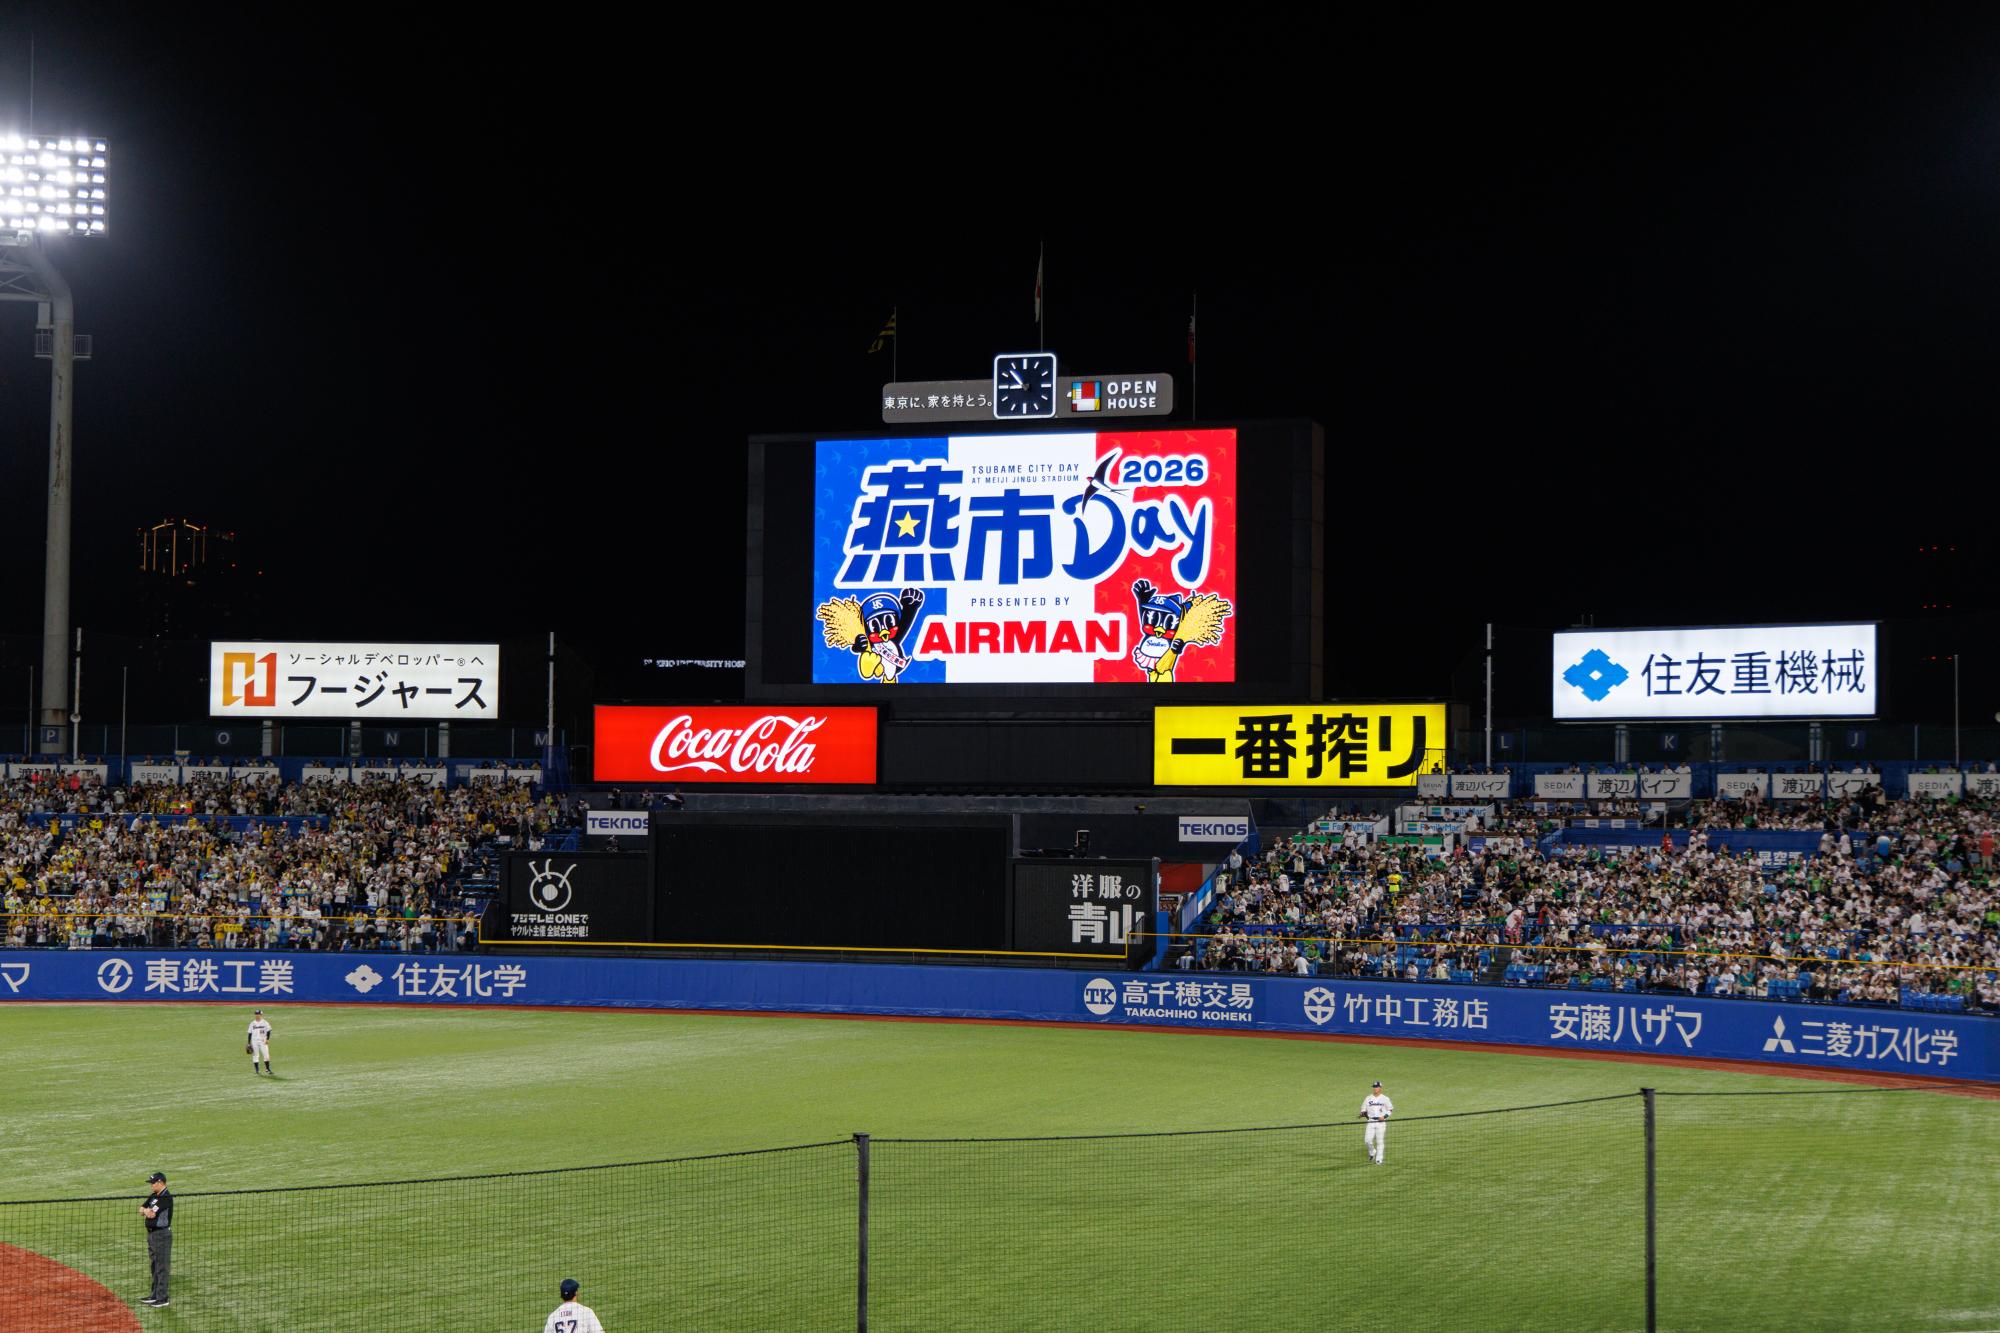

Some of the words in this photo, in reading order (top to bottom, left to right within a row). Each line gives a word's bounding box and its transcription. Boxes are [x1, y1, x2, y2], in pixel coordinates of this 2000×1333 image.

[1107, 380, 1157, 395] OPEN
[884, 394, 992, 409] 東京に、家を持とう。
[1107, 397, 1156, 409] HOUSE
[972, 465, 1022, 475] TSUBAME
[1028, 464, 1053, 473] CITY
[1059, 463, 1079, 472] DAY
[1122, 459, 1204, 483] 2026
[972, 477, 981, 485] AT
[1041, 475, 1079, 483] STADIUM
[971, 596, 1047, 607] PRESENTED
[1055, 596, 1070, 606] BY
[920, 620, 1120, 654] AIRMAN
[1641, 648, 1866, 696] 住友重機械
[287, 670, 487, 709] フージャース
[46, 729, 56, 742] P
[386, 733, 397, 745] N
[535, 733, 548, 746] M
[1501, 736, 1509, 749] L
[1664, 735, 1674, 749] K
[1851, 732, 1859, 747] J
[650, 715, 828, 774] Coca-Cola
[1455, 780, 1506, 791] 渡辺パイプ
[1597, 778, 1680, 794] 渡辺パイプ
[1180, 823, 1248, 836] TEKNOS
[1072, 873, 1142, 899] 洋服の
[511, 913, 589, 924] フジテレビONEで
[1068, 901, 1146, 945] 青山
[145, 957, 294, 995] 東鉄工業
[391, 962, 527, 998] 住友化学
[1122, 979, 1254, 1009] 高千穂交易
[1125, 1007, 1198, 1019] TAKACHIHO
[1202, 1011, 1252, 1022] KOHEKI
[1344, 992, 1489, 1030] 竹中工務店
[1549, 1002, 1703, 1048] 安藤ハザマ
[1800, 1021, 1958, 1066] 三菱ガス化学
